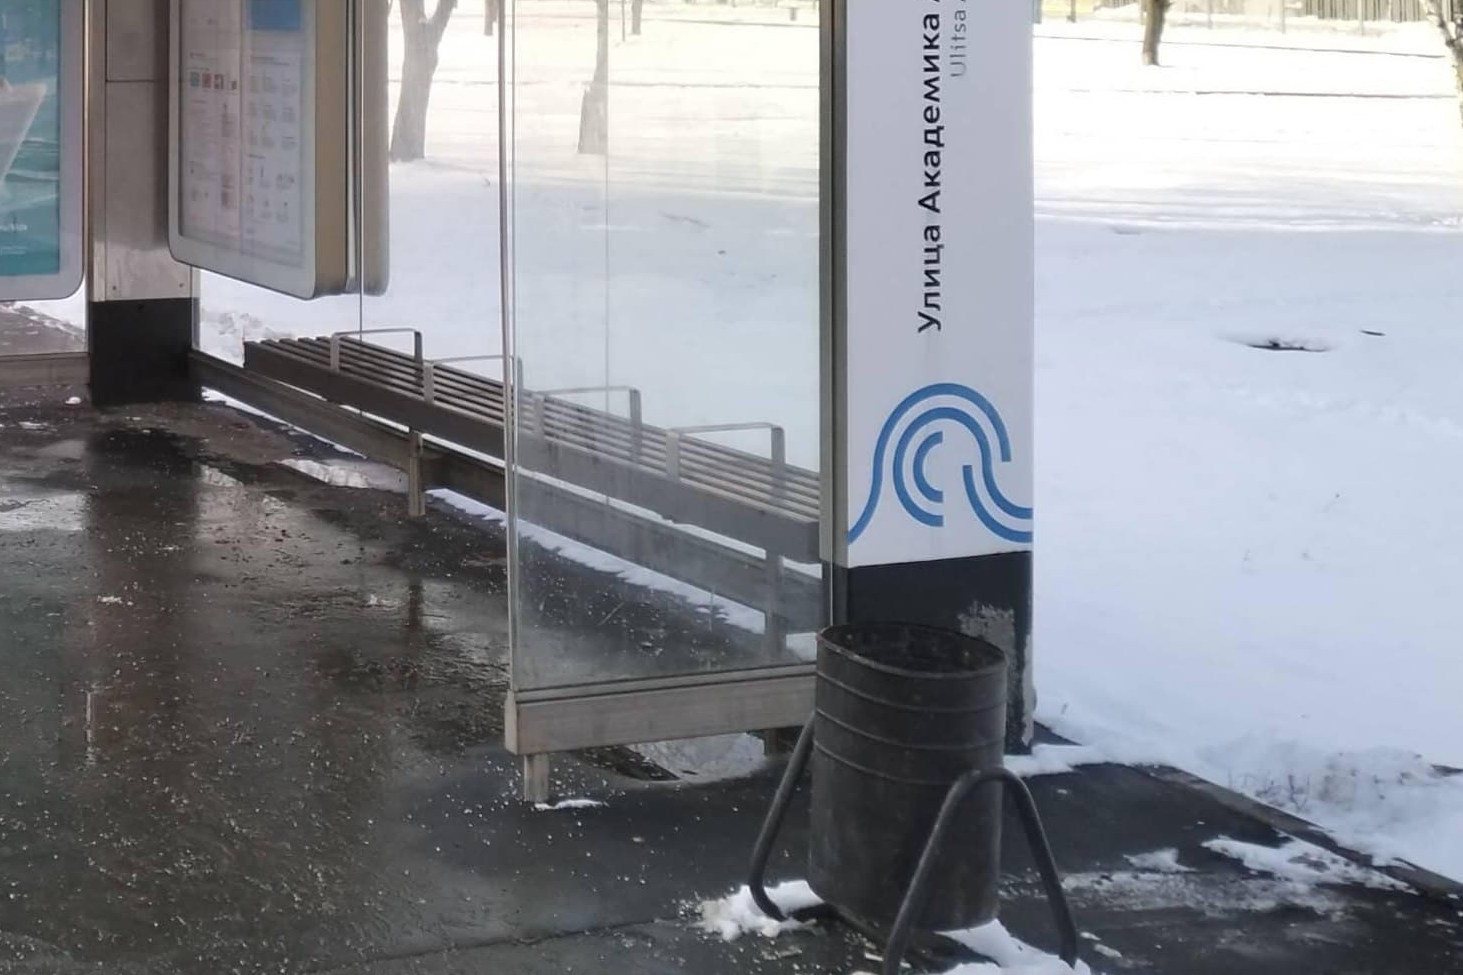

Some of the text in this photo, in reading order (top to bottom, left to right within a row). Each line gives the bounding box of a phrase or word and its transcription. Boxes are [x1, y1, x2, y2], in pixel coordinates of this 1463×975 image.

[949, 9, 968, 78] Ulitsa
[917, 13, 946, 213] Академика
[917, 225, 945, 333] Улица
